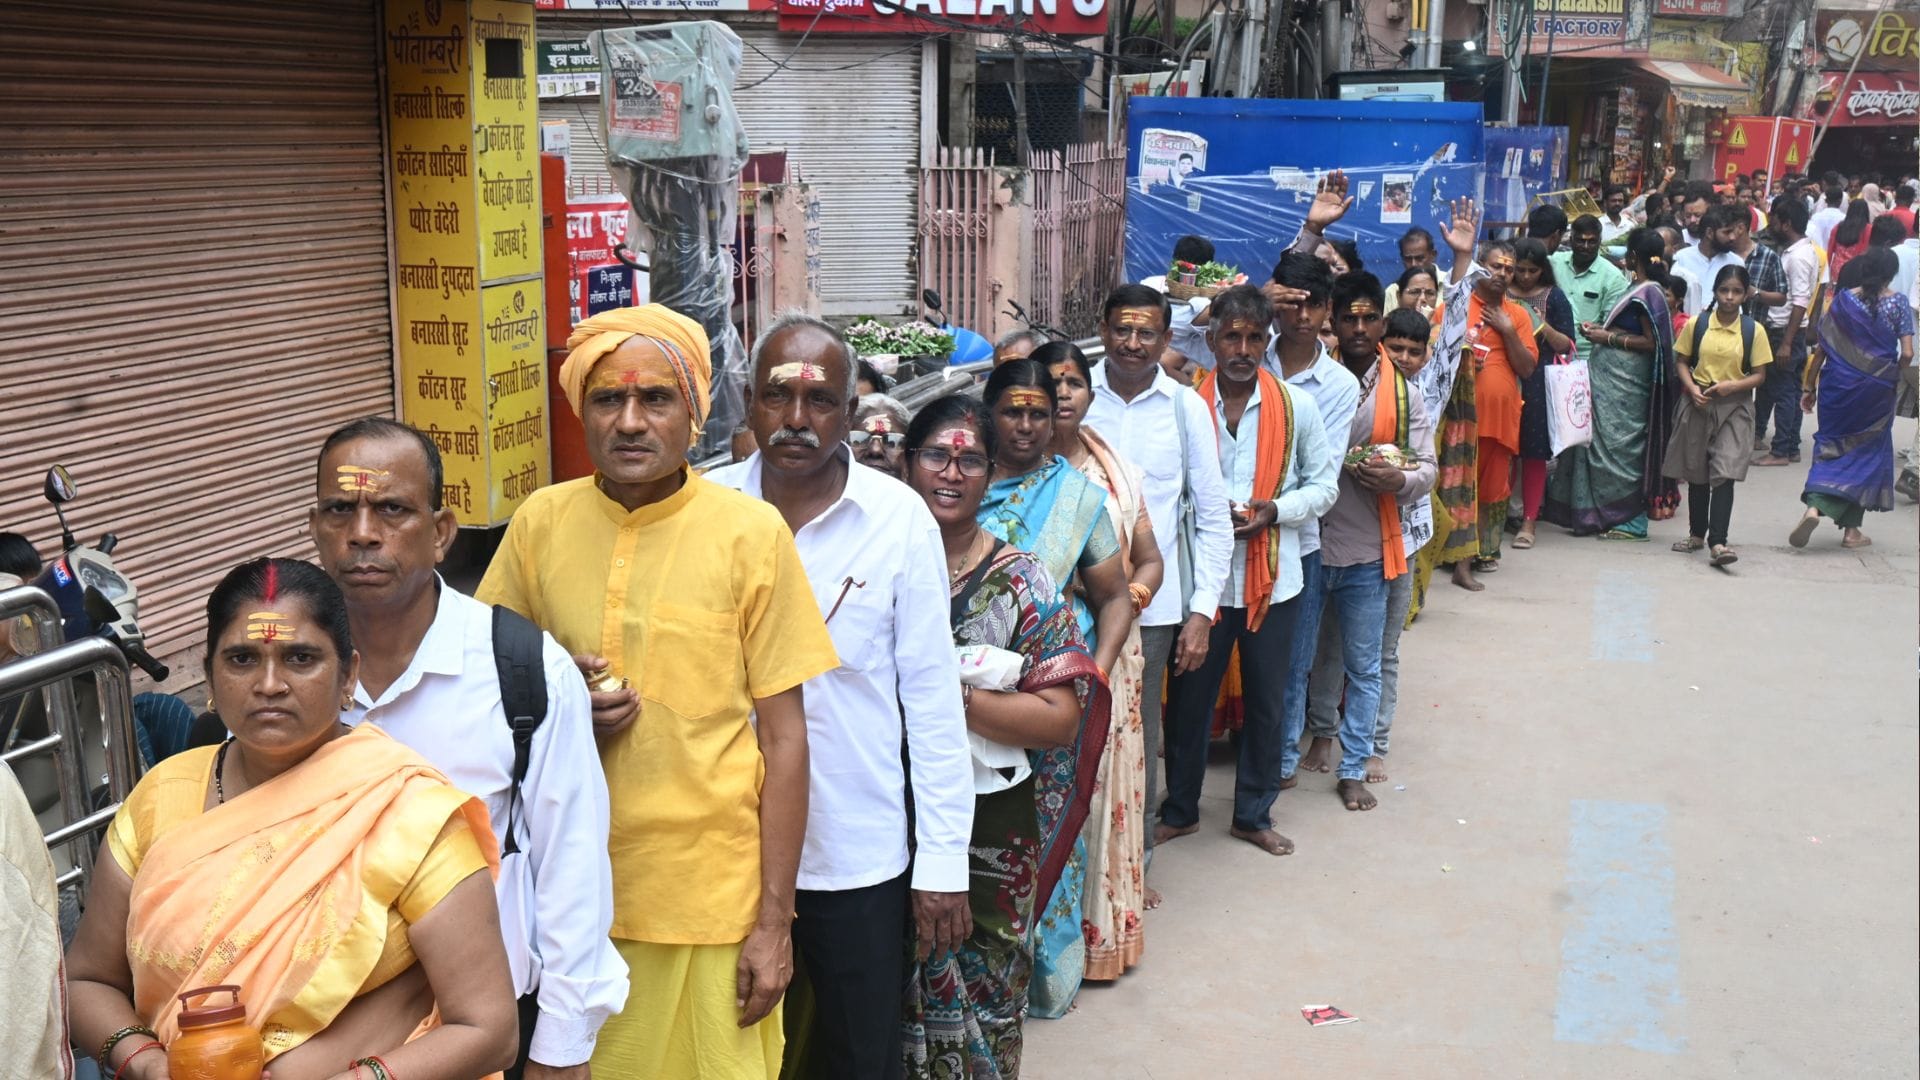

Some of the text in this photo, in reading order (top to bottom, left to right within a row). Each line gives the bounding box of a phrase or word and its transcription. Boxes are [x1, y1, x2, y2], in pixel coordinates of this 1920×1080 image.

[1544, 19, 1622, 37] FACTORY
[389, 24, 464, 74] पीताम्बरी
[393, 86, 465, 119] बनारसी सिल्क
[488, 117, 525, 161] कॉटन सूट
[396, 144, 427, 177] कॉटन
[409, 201, 460, 236] प्योर चंदेरी
[566, 211, 594, 239] ला
[493, 220, 528, 260] उपलब्ध है
[400, 258, 474, 299] बनारसी दुपट्टा
[411, 314, 468, 355] बनारसी सूट
[487, 309, 539, 344] पीताम्बरी
[418, 369, 467, 410] कॉटन सूट
[520, 359, 540, 391] सिल्क
[454, 424, 479, 462] साड़ी
[493, 418, 515, 452] कॉटन
[462, 477, 472, 514] है
[502, 469, 519, 500] प्योर
